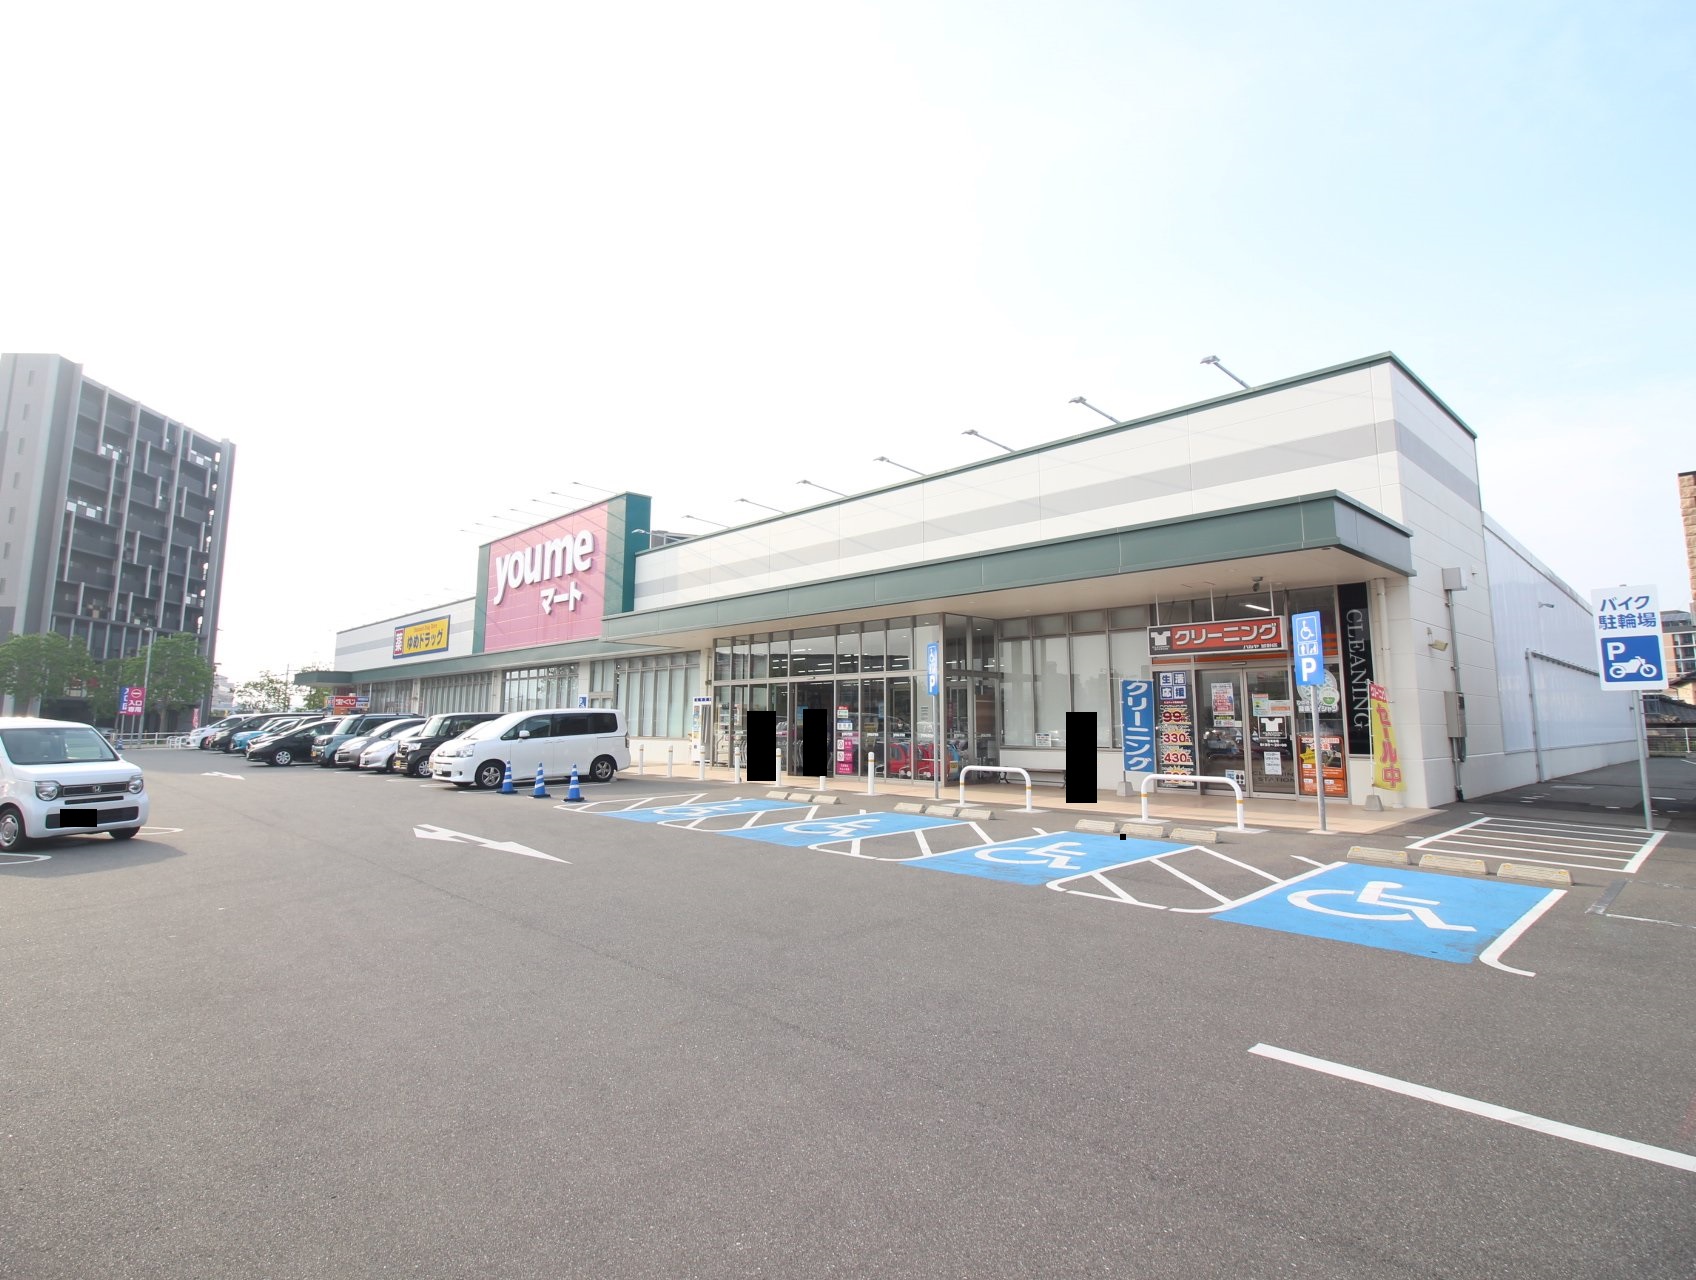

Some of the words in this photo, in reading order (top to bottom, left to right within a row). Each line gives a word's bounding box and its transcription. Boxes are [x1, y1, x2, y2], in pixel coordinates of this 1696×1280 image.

[494, 530, 595, 605] youme
[541, 581, 584, 615] マート
[1600, 596, 1650, 611] バイク
[1599, 612, 1657, 630] 駐輪場
[407, 628, 443, 651] ゆめドラッグ
[1174, 622, 1277, 645] クリーニング
[1607, 642, 1625, 661] P
[1301, 658, 1317, 681] P
[1346, 609, 1370, 728] CLEANING
[929, 675, 936, 692] P
[1126, 682, 1152, 770] クリーニング
[1376, 703, 1402, 788] セール中
